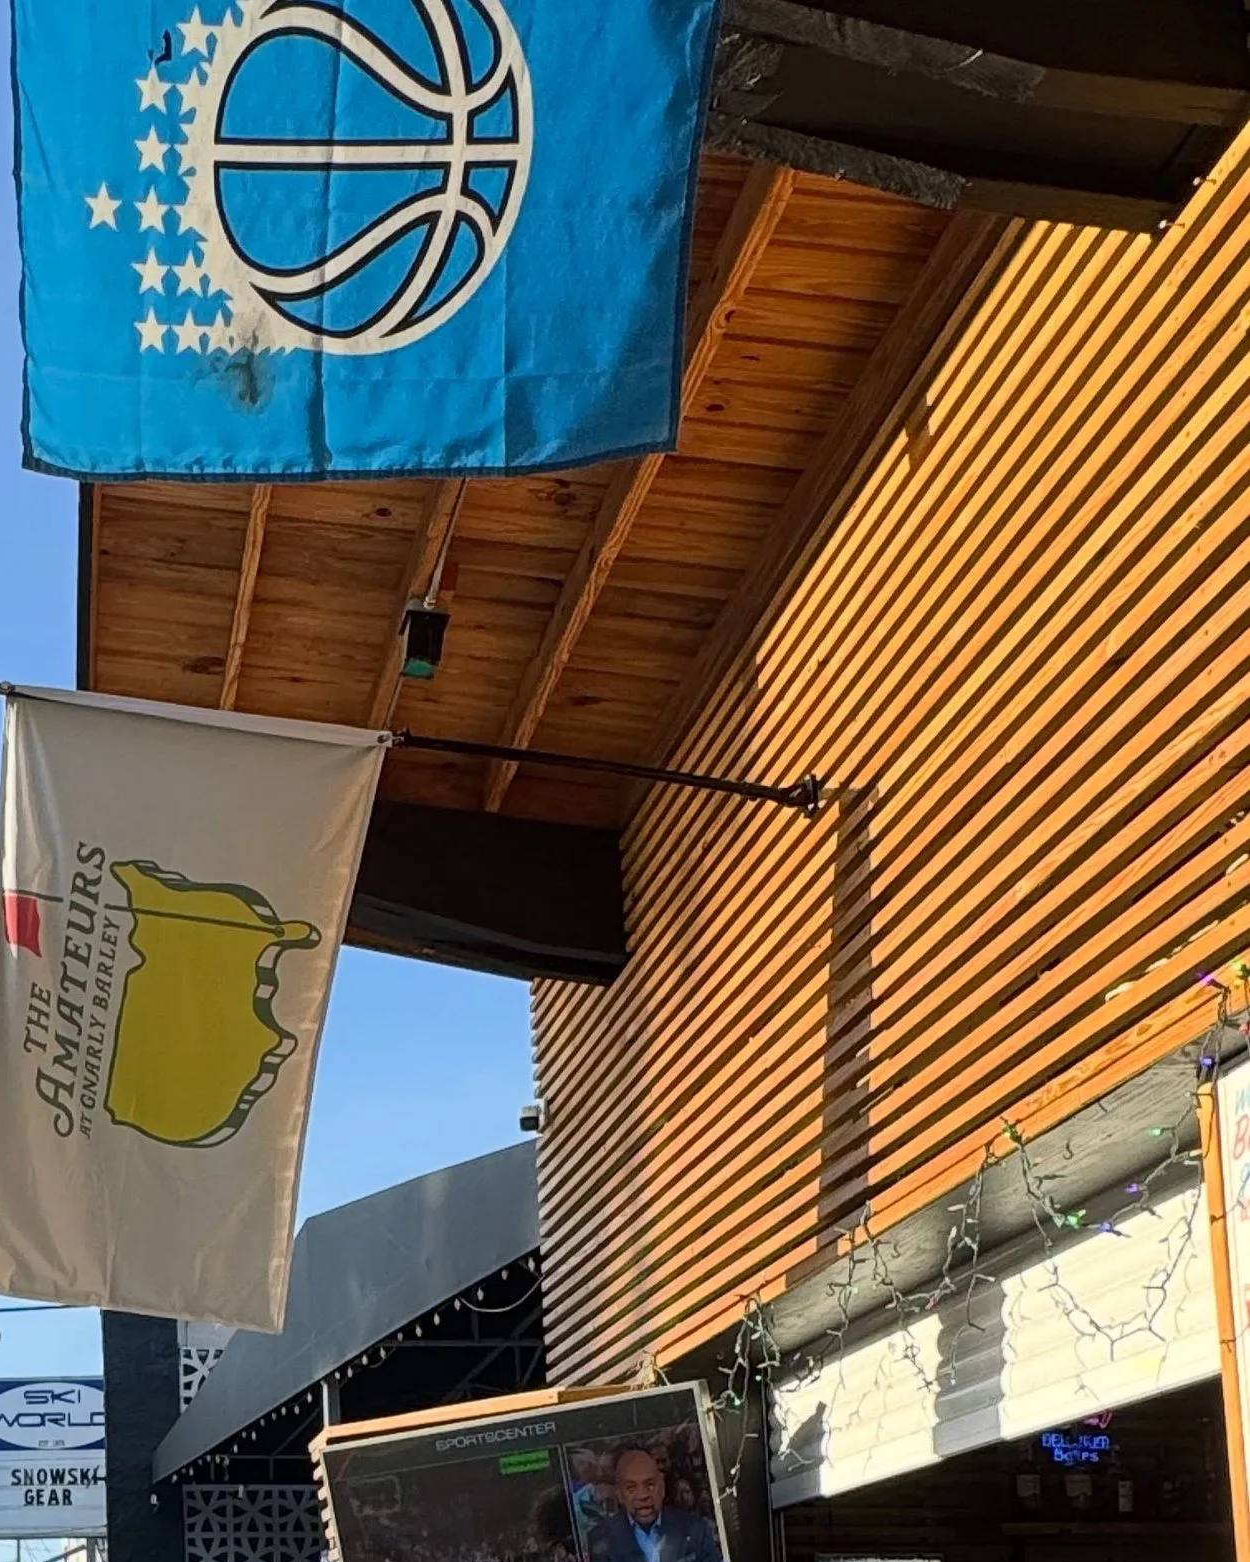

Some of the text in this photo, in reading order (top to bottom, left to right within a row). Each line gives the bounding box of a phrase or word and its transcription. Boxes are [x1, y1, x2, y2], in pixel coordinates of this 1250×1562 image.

[35, 841, 106, 1139] AMATEURS
[23, 981, 52, 1054] THE
[79, 914, 121, 1140] AT GNARLY BARLEY
[24, 1389, 81, 1405] SKI
[434, 1421, 557, 1452] SPORTSCENTER
[23, 1489, 73, 1507] GEAR
